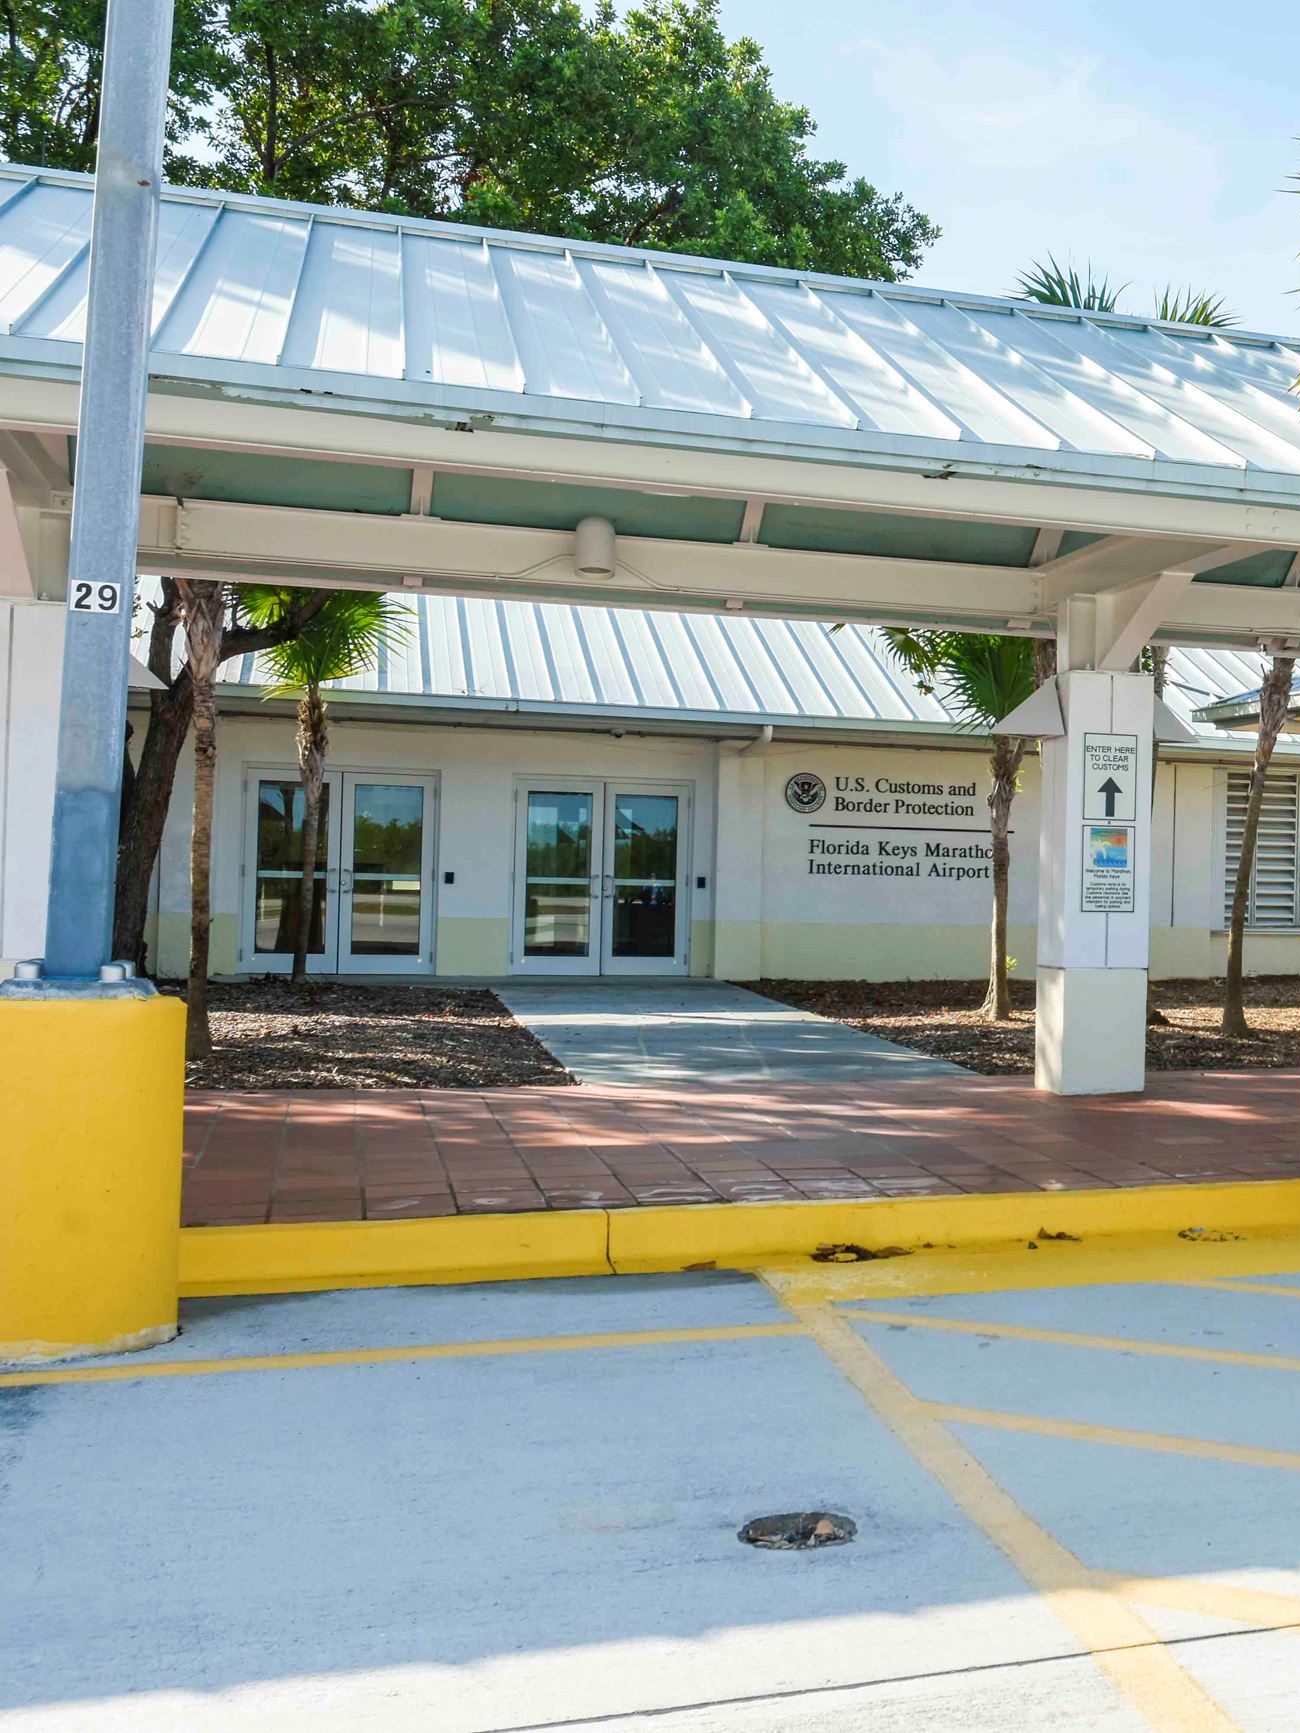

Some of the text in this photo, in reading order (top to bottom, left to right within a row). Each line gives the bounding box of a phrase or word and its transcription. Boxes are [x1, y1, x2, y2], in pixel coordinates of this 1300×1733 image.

[74, 582, 118, 611] 29
[1085, 745, 1136, 754] ENTER HERE
[1102, 754, 1129, 762] CLEAR
[1092, 763, 1129, 771] CUSTOMS
[834, 776, 870, 793] U.S.
[875, 778, 944, 796] Customs
[948, 782, 976, 797] and
[834, 797, 975, 817] Border Protection
[808, 839, 993, 860] Florida Keys Maratho
[808, 859, 990, 881] International Airport
